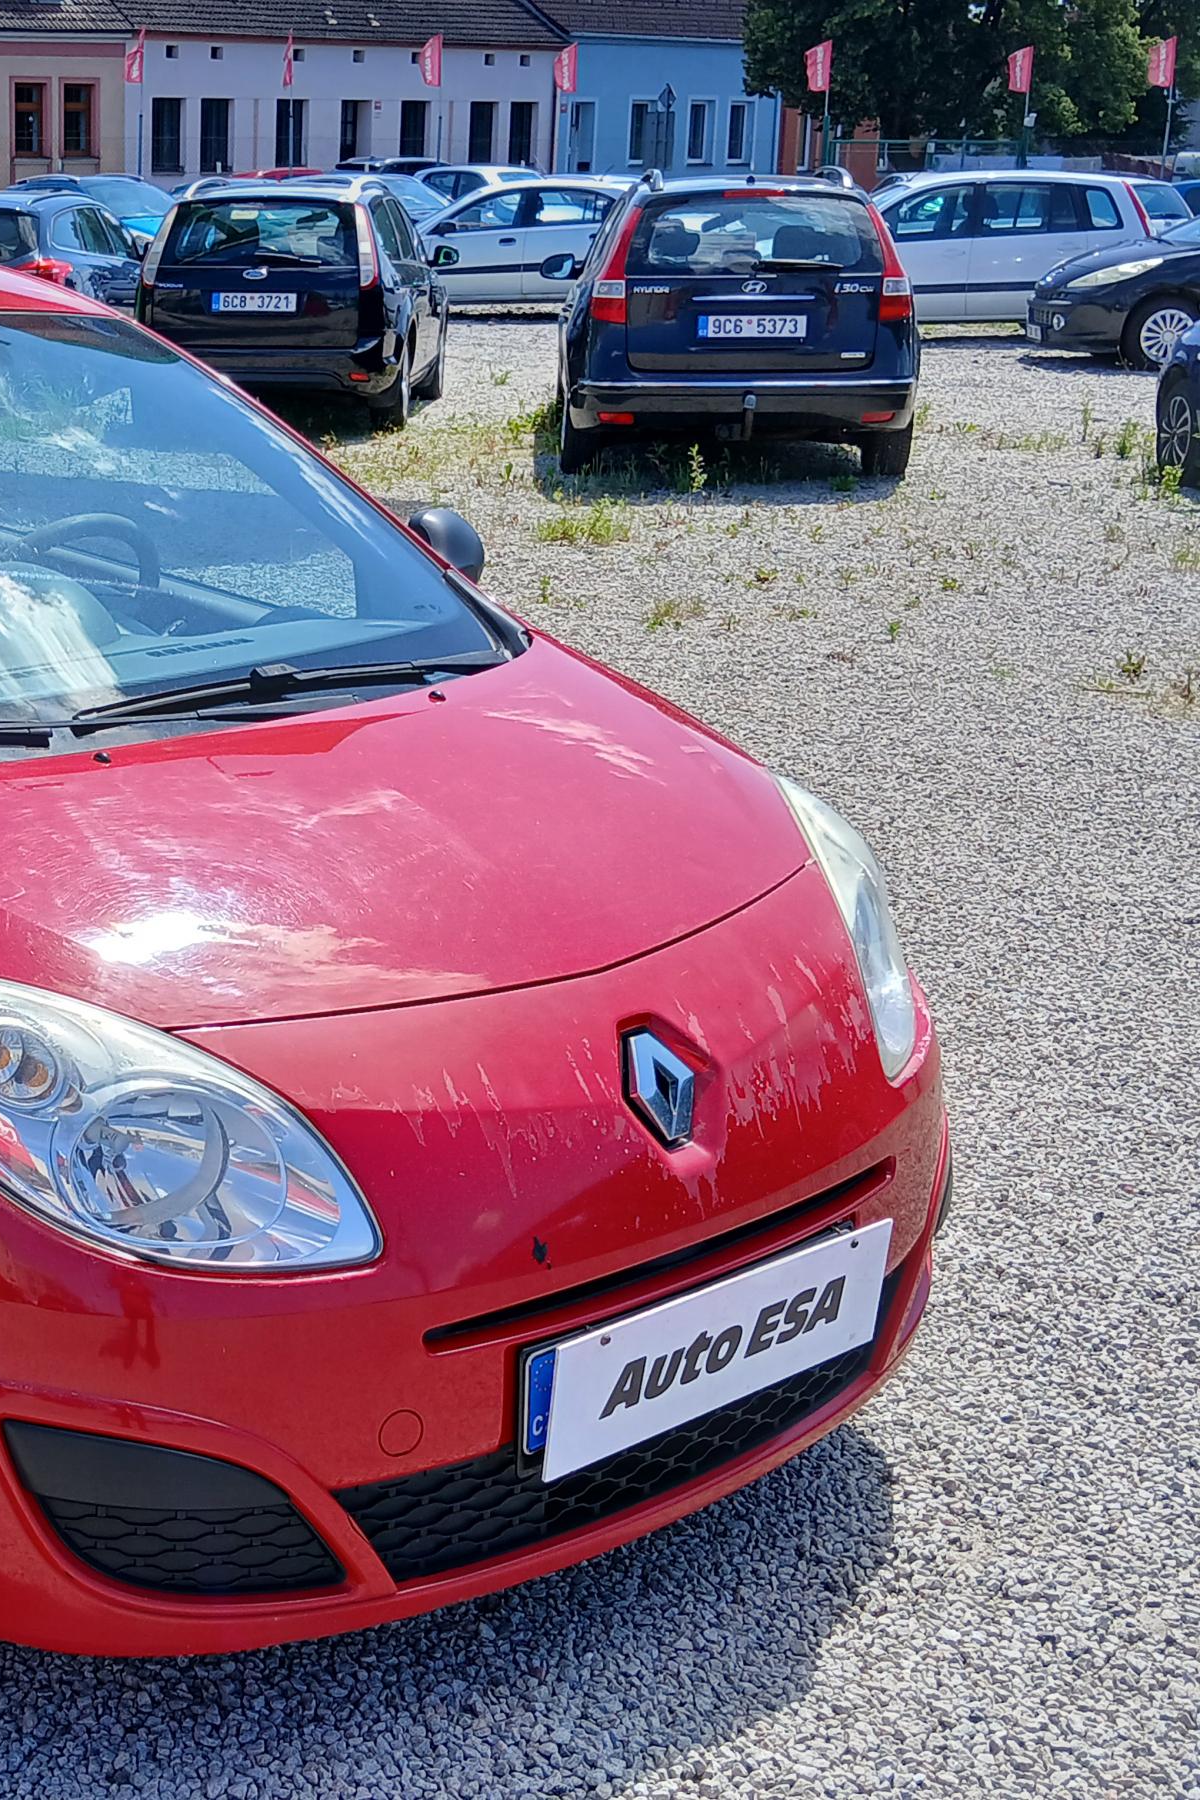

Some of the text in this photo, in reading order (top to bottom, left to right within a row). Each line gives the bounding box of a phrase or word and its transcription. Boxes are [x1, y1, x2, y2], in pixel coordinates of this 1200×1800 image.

[257, 295, 291, 309] 3721
[712, 318, 799, 335] 9C6 5373
[598, 1274, 847, 1421] Auto ESA
[531, 1411, 549, 1437] C
